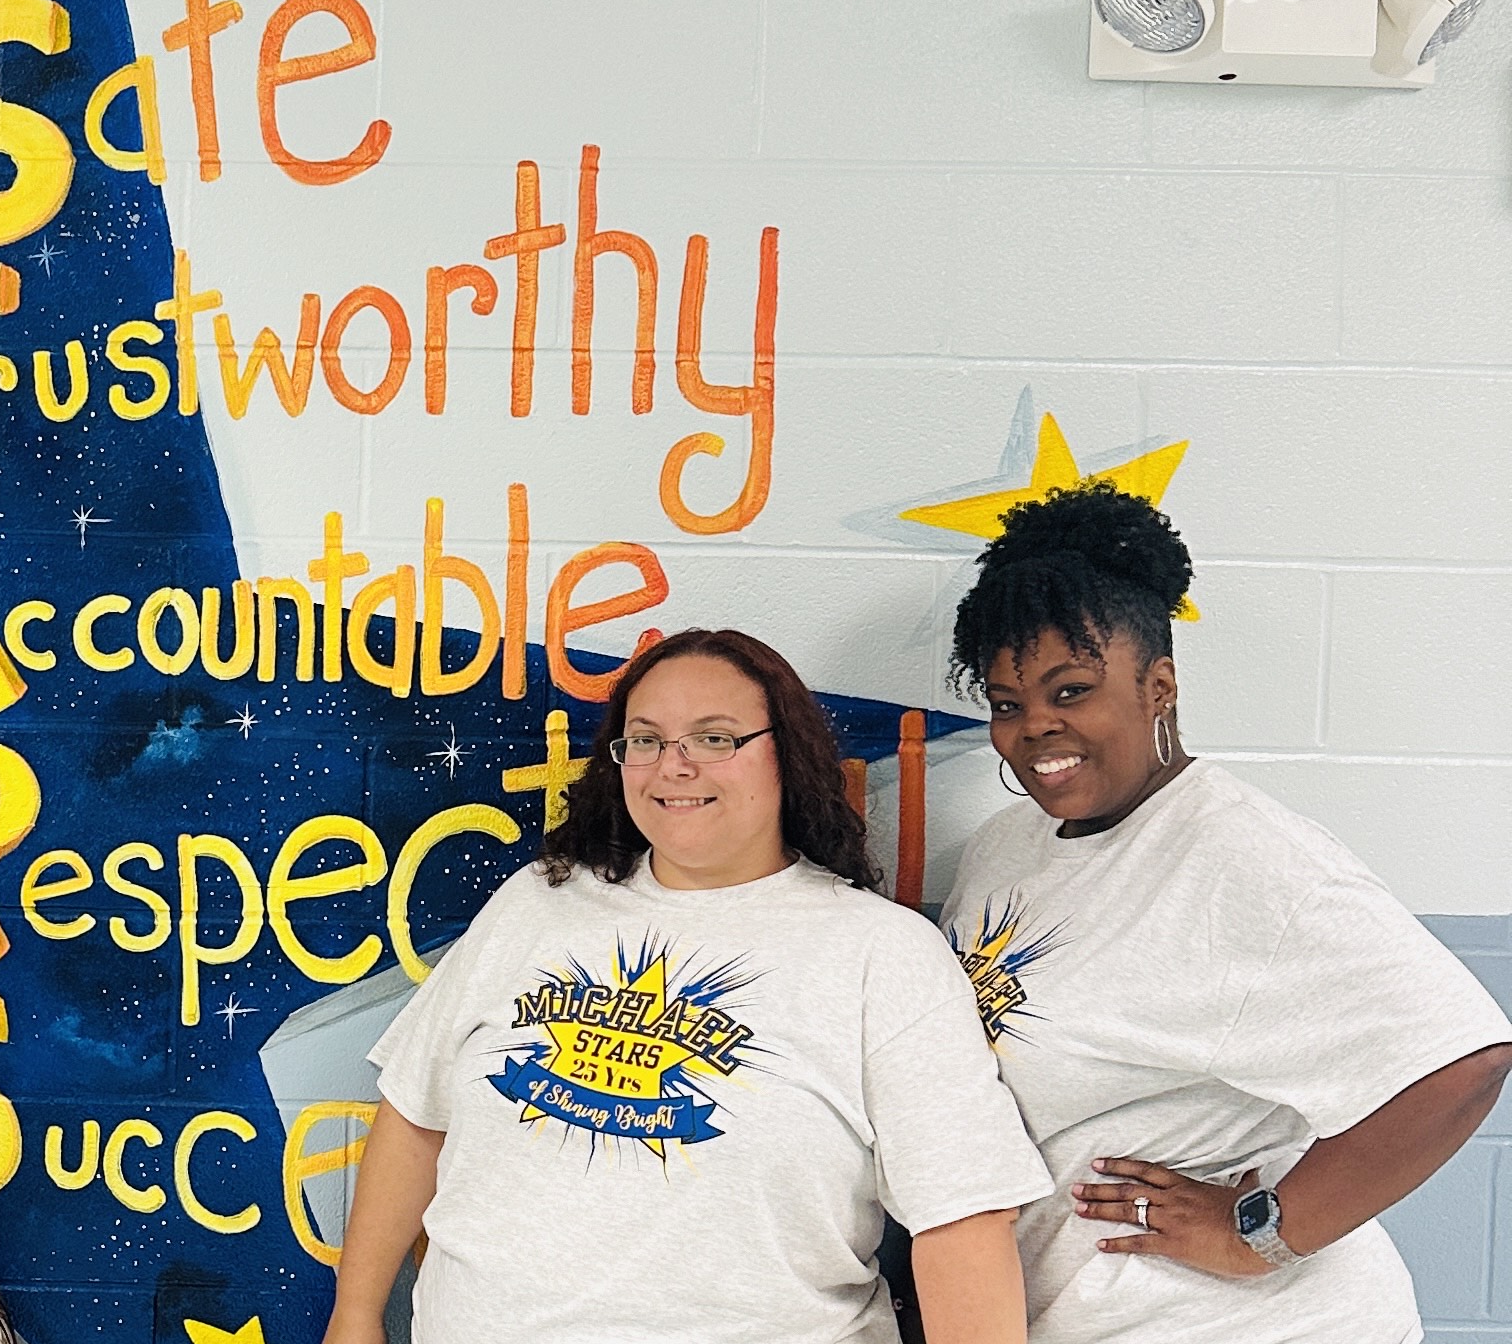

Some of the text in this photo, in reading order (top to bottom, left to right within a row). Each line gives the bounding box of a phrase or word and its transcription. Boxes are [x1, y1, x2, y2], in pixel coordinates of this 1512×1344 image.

[512, 982, 754, 1076] MICHAEL
[573, 1029, 664, 1070] STARS
[569, 1058, 643, 1093] 25 Yrs
[528, 1078, 684, 1134] of Shining Bright
